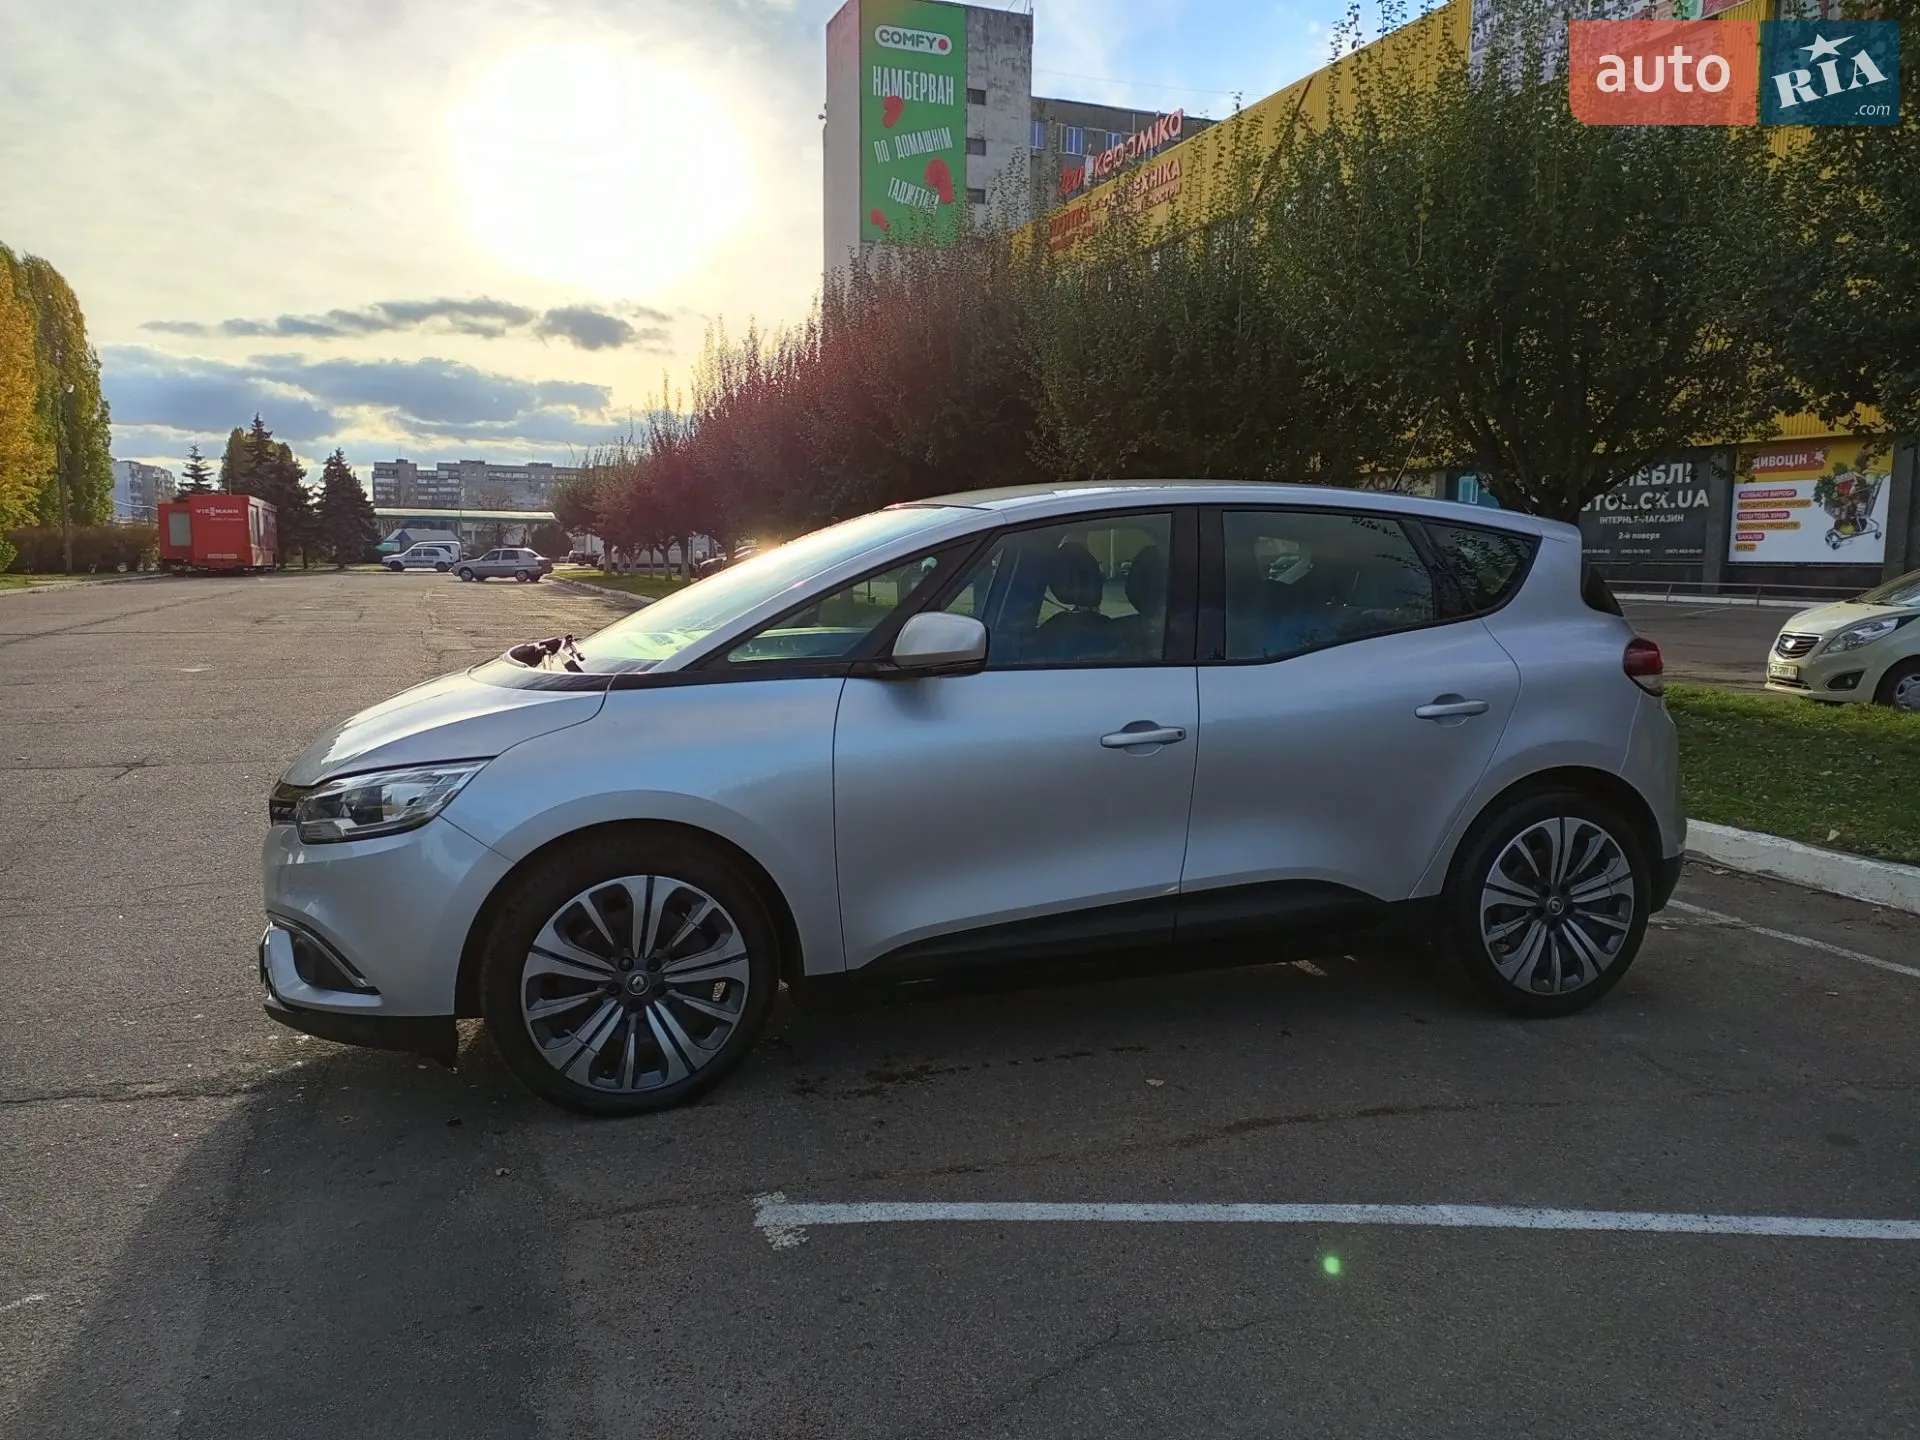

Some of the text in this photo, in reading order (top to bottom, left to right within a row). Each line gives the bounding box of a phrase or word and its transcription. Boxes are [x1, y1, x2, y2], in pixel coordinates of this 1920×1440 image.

[878, 29, 937, 50] COMFY
[872, 65, 955, 106] НАМБЕРВАН
[873, 127, 954, 165] ПО ДОМАШНІМ
[1750, 454, 1808, 470] ДИВОЦІН
